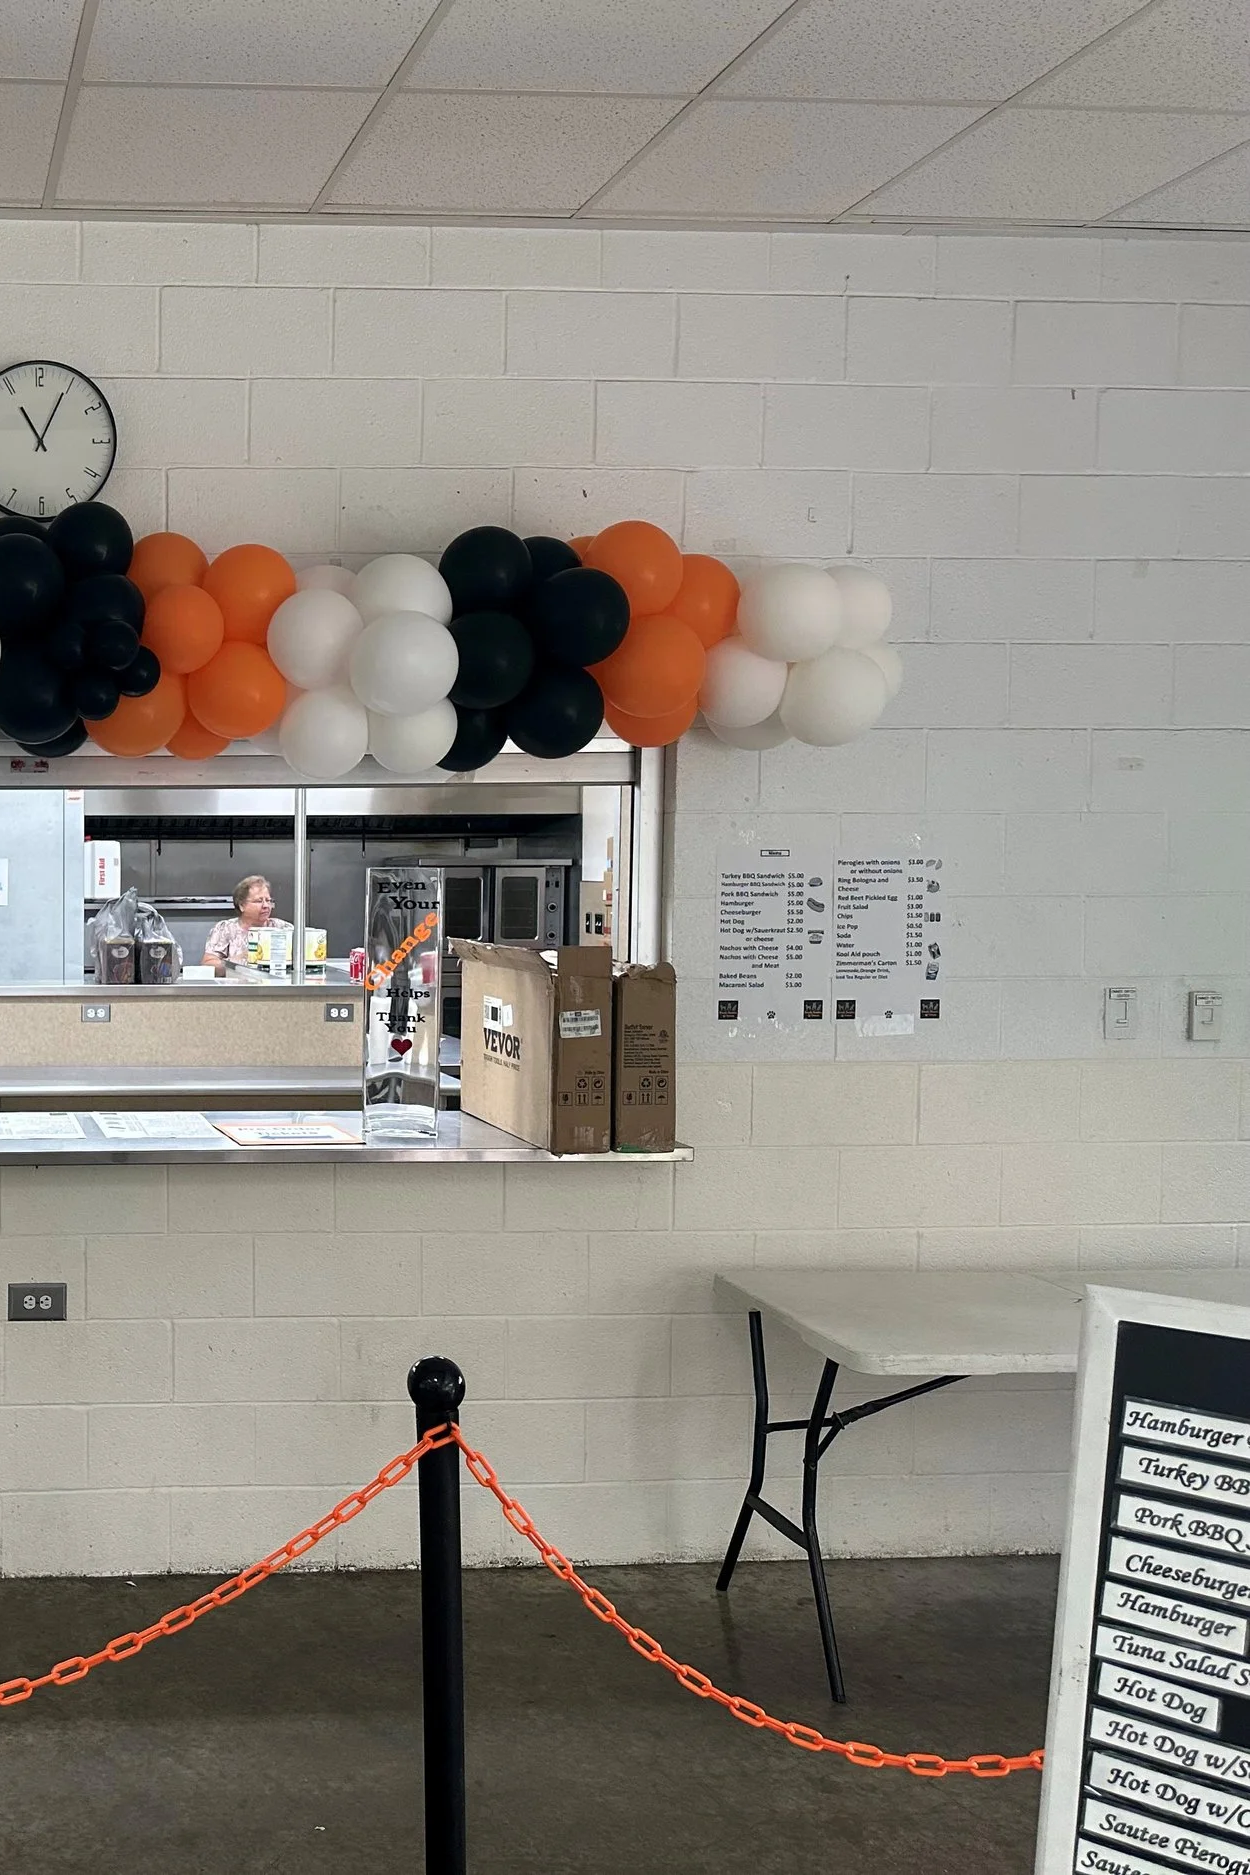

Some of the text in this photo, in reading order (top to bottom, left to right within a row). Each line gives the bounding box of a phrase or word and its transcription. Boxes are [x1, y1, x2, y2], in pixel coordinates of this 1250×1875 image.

[36, 368, 44, 387] 12
[85, 402, 101, 415] 2
[84, 467, 101, 478] 4
[7, 489, 17, 506] 7
[39, 497, 44, 515] 6
[65, 488, 78, 503] 5
[377, 882, 426, 893] Even
[389, 896, 440, 910] Your
[365, 912, 438, 991] Change
[386, 989, 430, 999] Helps
[376, 1012, 425, 1023] Thank
[384, 1023, 416, 1033] You
[483, 1028, 520, 1060] VEVOR
[1127, 1411, 1243, 1447] Hamburger
[1139, 1458, 1209, 1491] Turkey
[1135, 1508, 1246, 1553] Pork BBQ
[1117, 1592, 1236, 1636] Hamburger
[1113, 1635, 1165, 1662] Tuna
[1169, 1651, 1236, 1680] Salad
[1114, 1677, 1207, 1723] Hot Dog
[1106, 1721, 1148, 1746] Hot
[1154, 1735, 1199, 1766] Dog
[1107, 1769, 1151, 1793] Hot
[1156, 1783, 1201, 1814] Dog
[1099, 1814, 1170, 1848] Sautee
